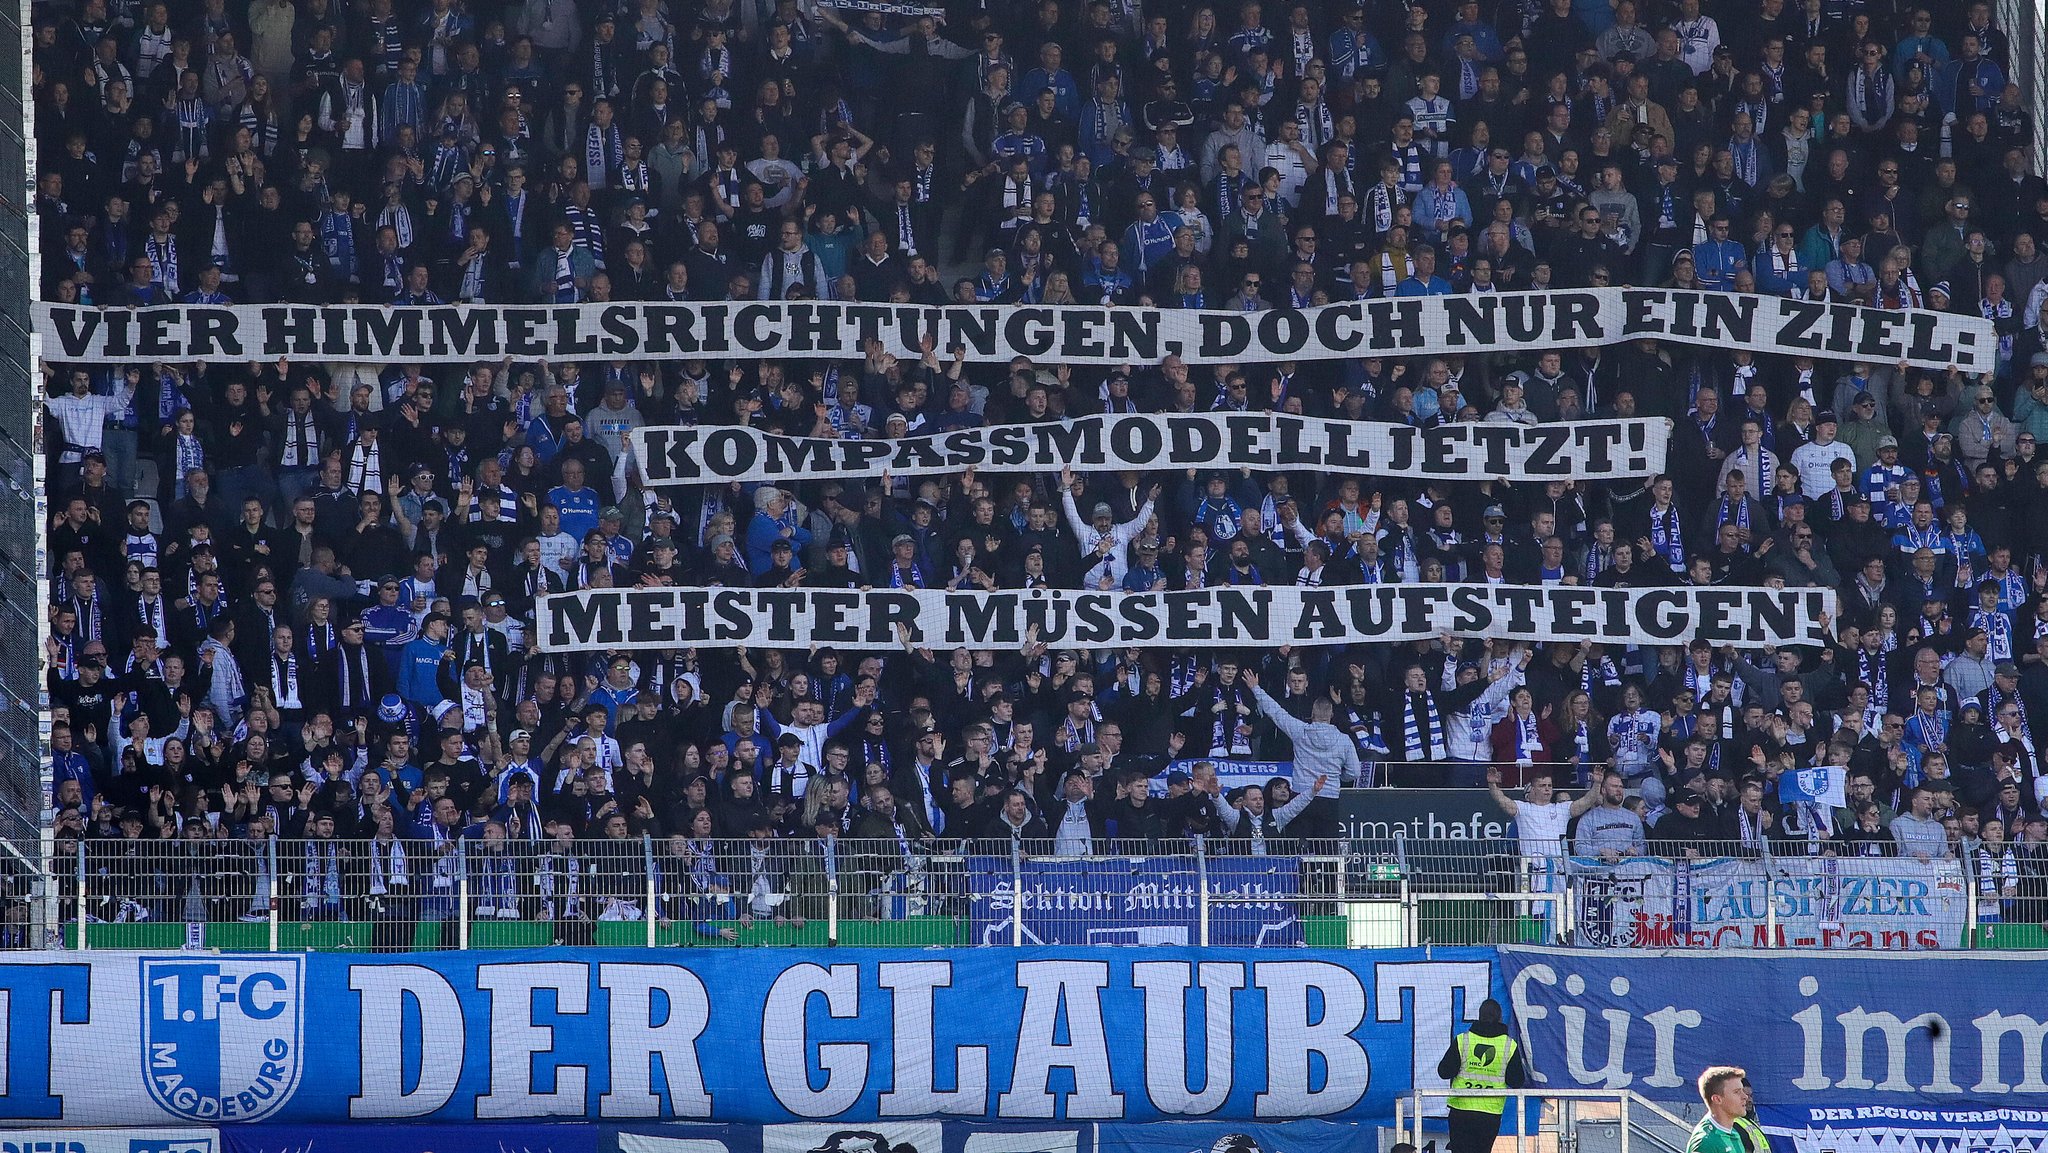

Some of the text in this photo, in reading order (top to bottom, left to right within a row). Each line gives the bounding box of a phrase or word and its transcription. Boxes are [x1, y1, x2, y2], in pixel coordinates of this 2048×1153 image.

[50, 291, 1976, 364] VIER HIMMELSRICHTUNGEN, DOCH NUR EIN ZIEL:
[643, 416, 1647, 480] KOMPASSMODELL JETZT!
[547, 586, 1824, 645] MEISTER MÜSSEN AUFSTEIGEN!
[990, 881, 1286, 912] Sektion Mittlelbe
[152, 970, 288, 1022] 1.FC
[1510, 963, 1702, 1090] für
[348, 961, 714, 1119] DER
[761, 960, 1492, 1119] GLAUBT
[151, 1037, 289, 1120] MAGDEBURG
[1809, 1107, 1855, 1121] DER
[1856, 1105, 1938, 1122] REGION
